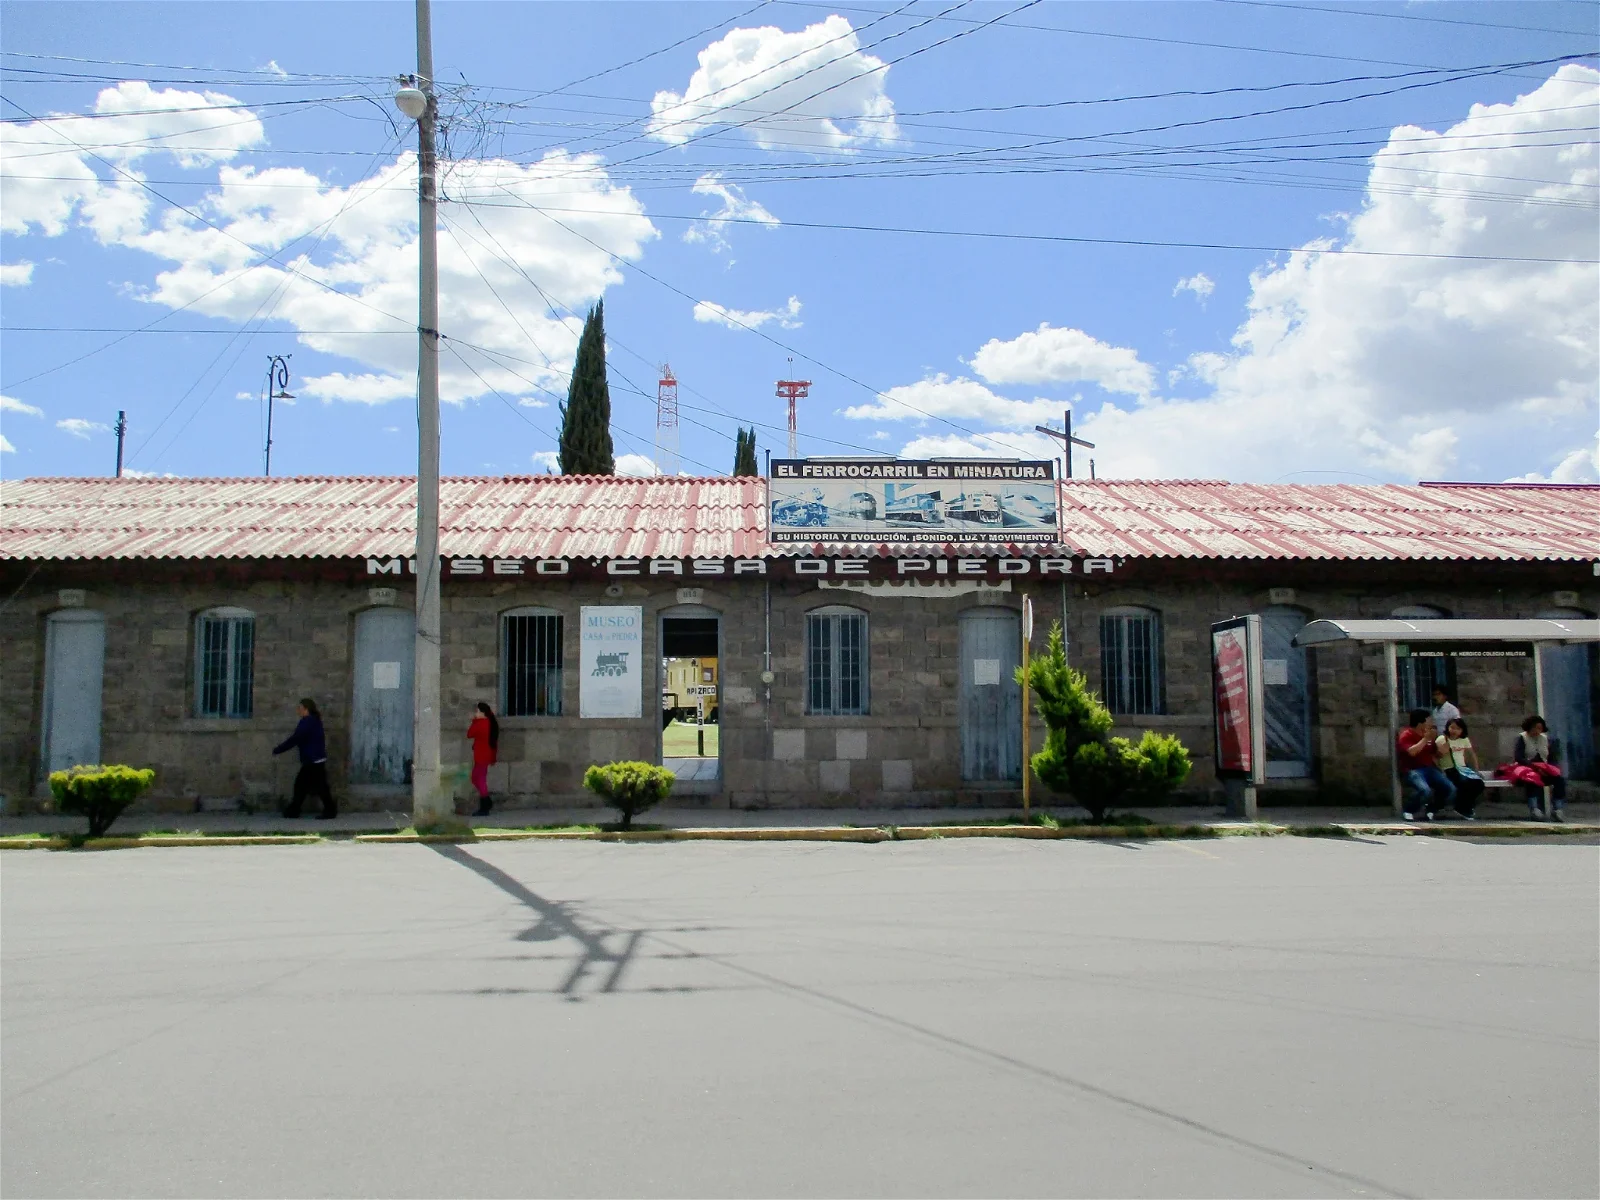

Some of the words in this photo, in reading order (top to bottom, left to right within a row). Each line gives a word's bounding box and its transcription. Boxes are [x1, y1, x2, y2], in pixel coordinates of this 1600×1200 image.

[777, 465, 798, 477] EL
[802, 465, 922, 477] FERROCARRIL
[926, 466, 949, 477] EN
[954, 466, 1047, 478] MINIATURA
[777, 533, 790, 541] SU
[793, 533, 839, 541] HISTORIA
[841, 533, 849, 541] Y
[850, 532, 910, 541] EVOLUCIÓN.
[912, 534, 957, 543] ¡SONIDO,
[366, 559, 569, 575] MSEO
[606, 559, 767, 575] CASA
[795, 559, 870, 575] DE
[897, 559, 1114, 574] PIEDRA
[588, 616, 634, 628] MUSEO
[583, 633, 603, 641] CASA
[612, 633, 638, 641] PIEDRA
